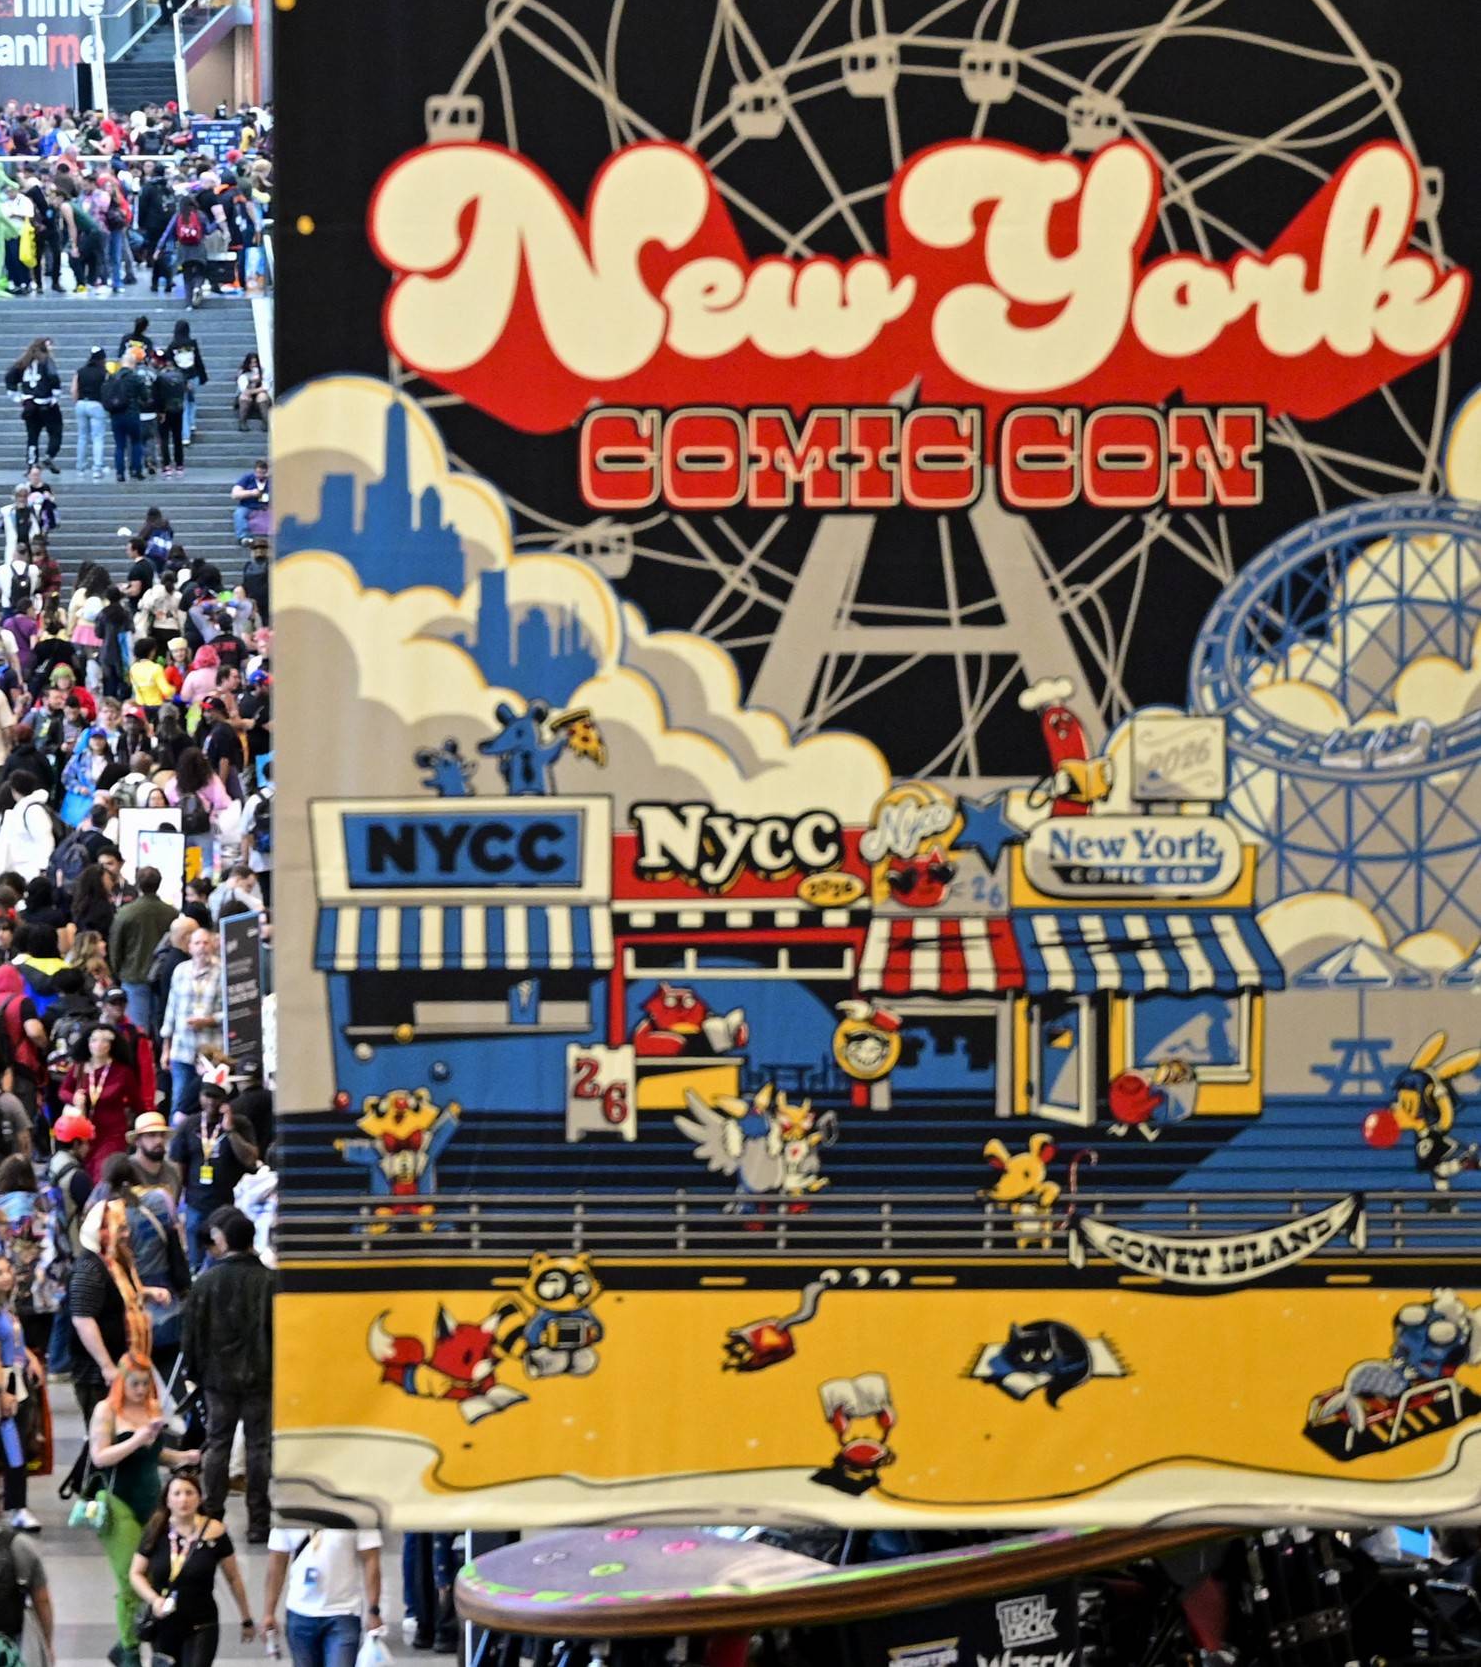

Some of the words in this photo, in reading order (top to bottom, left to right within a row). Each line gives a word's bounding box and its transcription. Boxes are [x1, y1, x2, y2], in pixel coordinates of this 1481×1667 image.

[371, 139, 915, 381] New
[900, 139, 1467, 394] York
[578, 405, 984, 511] COMIC
[998, 405, 1266, 511] CON
[365, 820, 566, 876] NYCC
[1048, 829, 1123, 861] New
[1134, 829, 1223, 861] York
[1070, 866, 1148, 884] COMIC
[1155, 866, 1205, 884] CON
[1218, 1216, 1334, 1274] ISLAND
[1004, 1599, 1044, 1622] TECH
[1010, 1615, 1053, 1641] DECK
